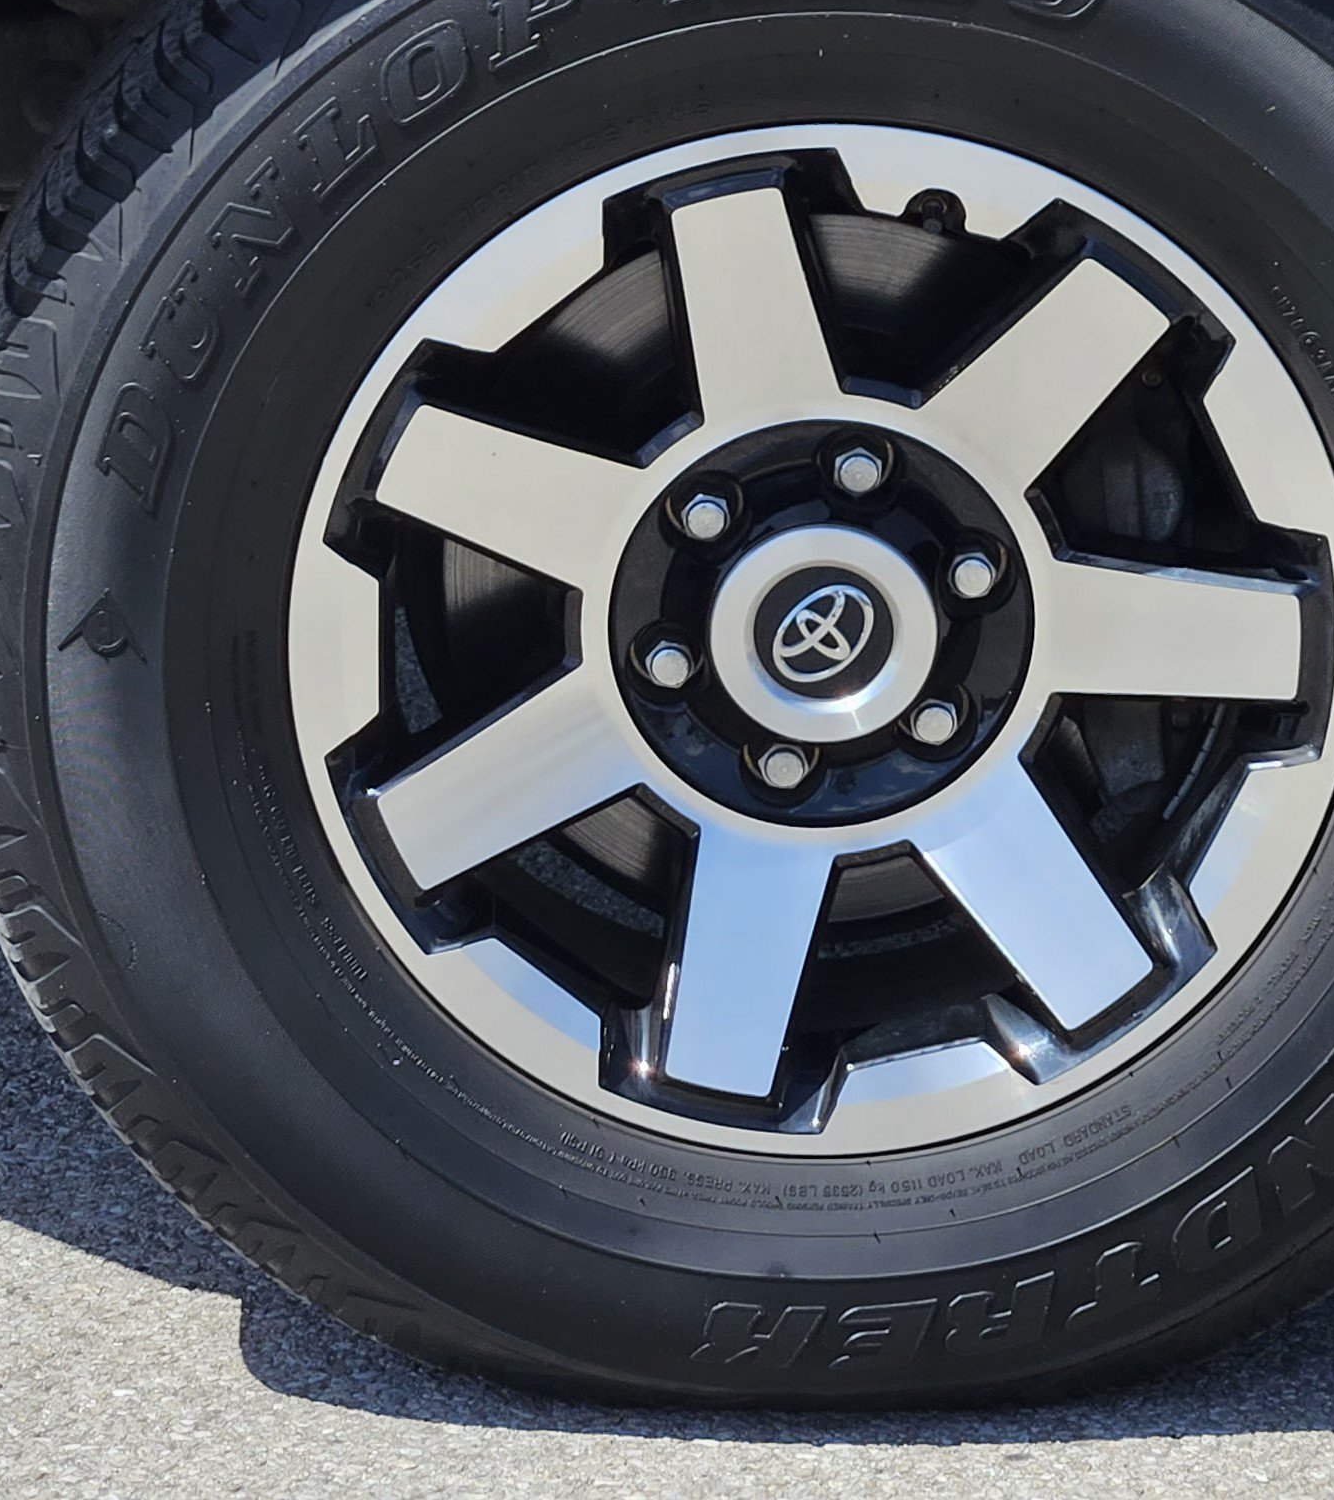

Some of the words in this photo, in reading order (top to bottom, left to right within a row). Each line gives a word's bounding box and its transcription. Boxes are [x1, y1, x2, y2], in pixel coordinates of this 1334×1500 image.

[1062, 1103, 1133, 1148] STANDARD
[1018, 1140, 1057, 1166] LOAD
[867, 1178, 886, 1196] kg
[890, 1176, 924, 1194] 1150
[927, 1169, 967, 1189] LOAD
[781, 1182, 818, 1198] LBS)
[821, 1182, 864, 1198] (2535
